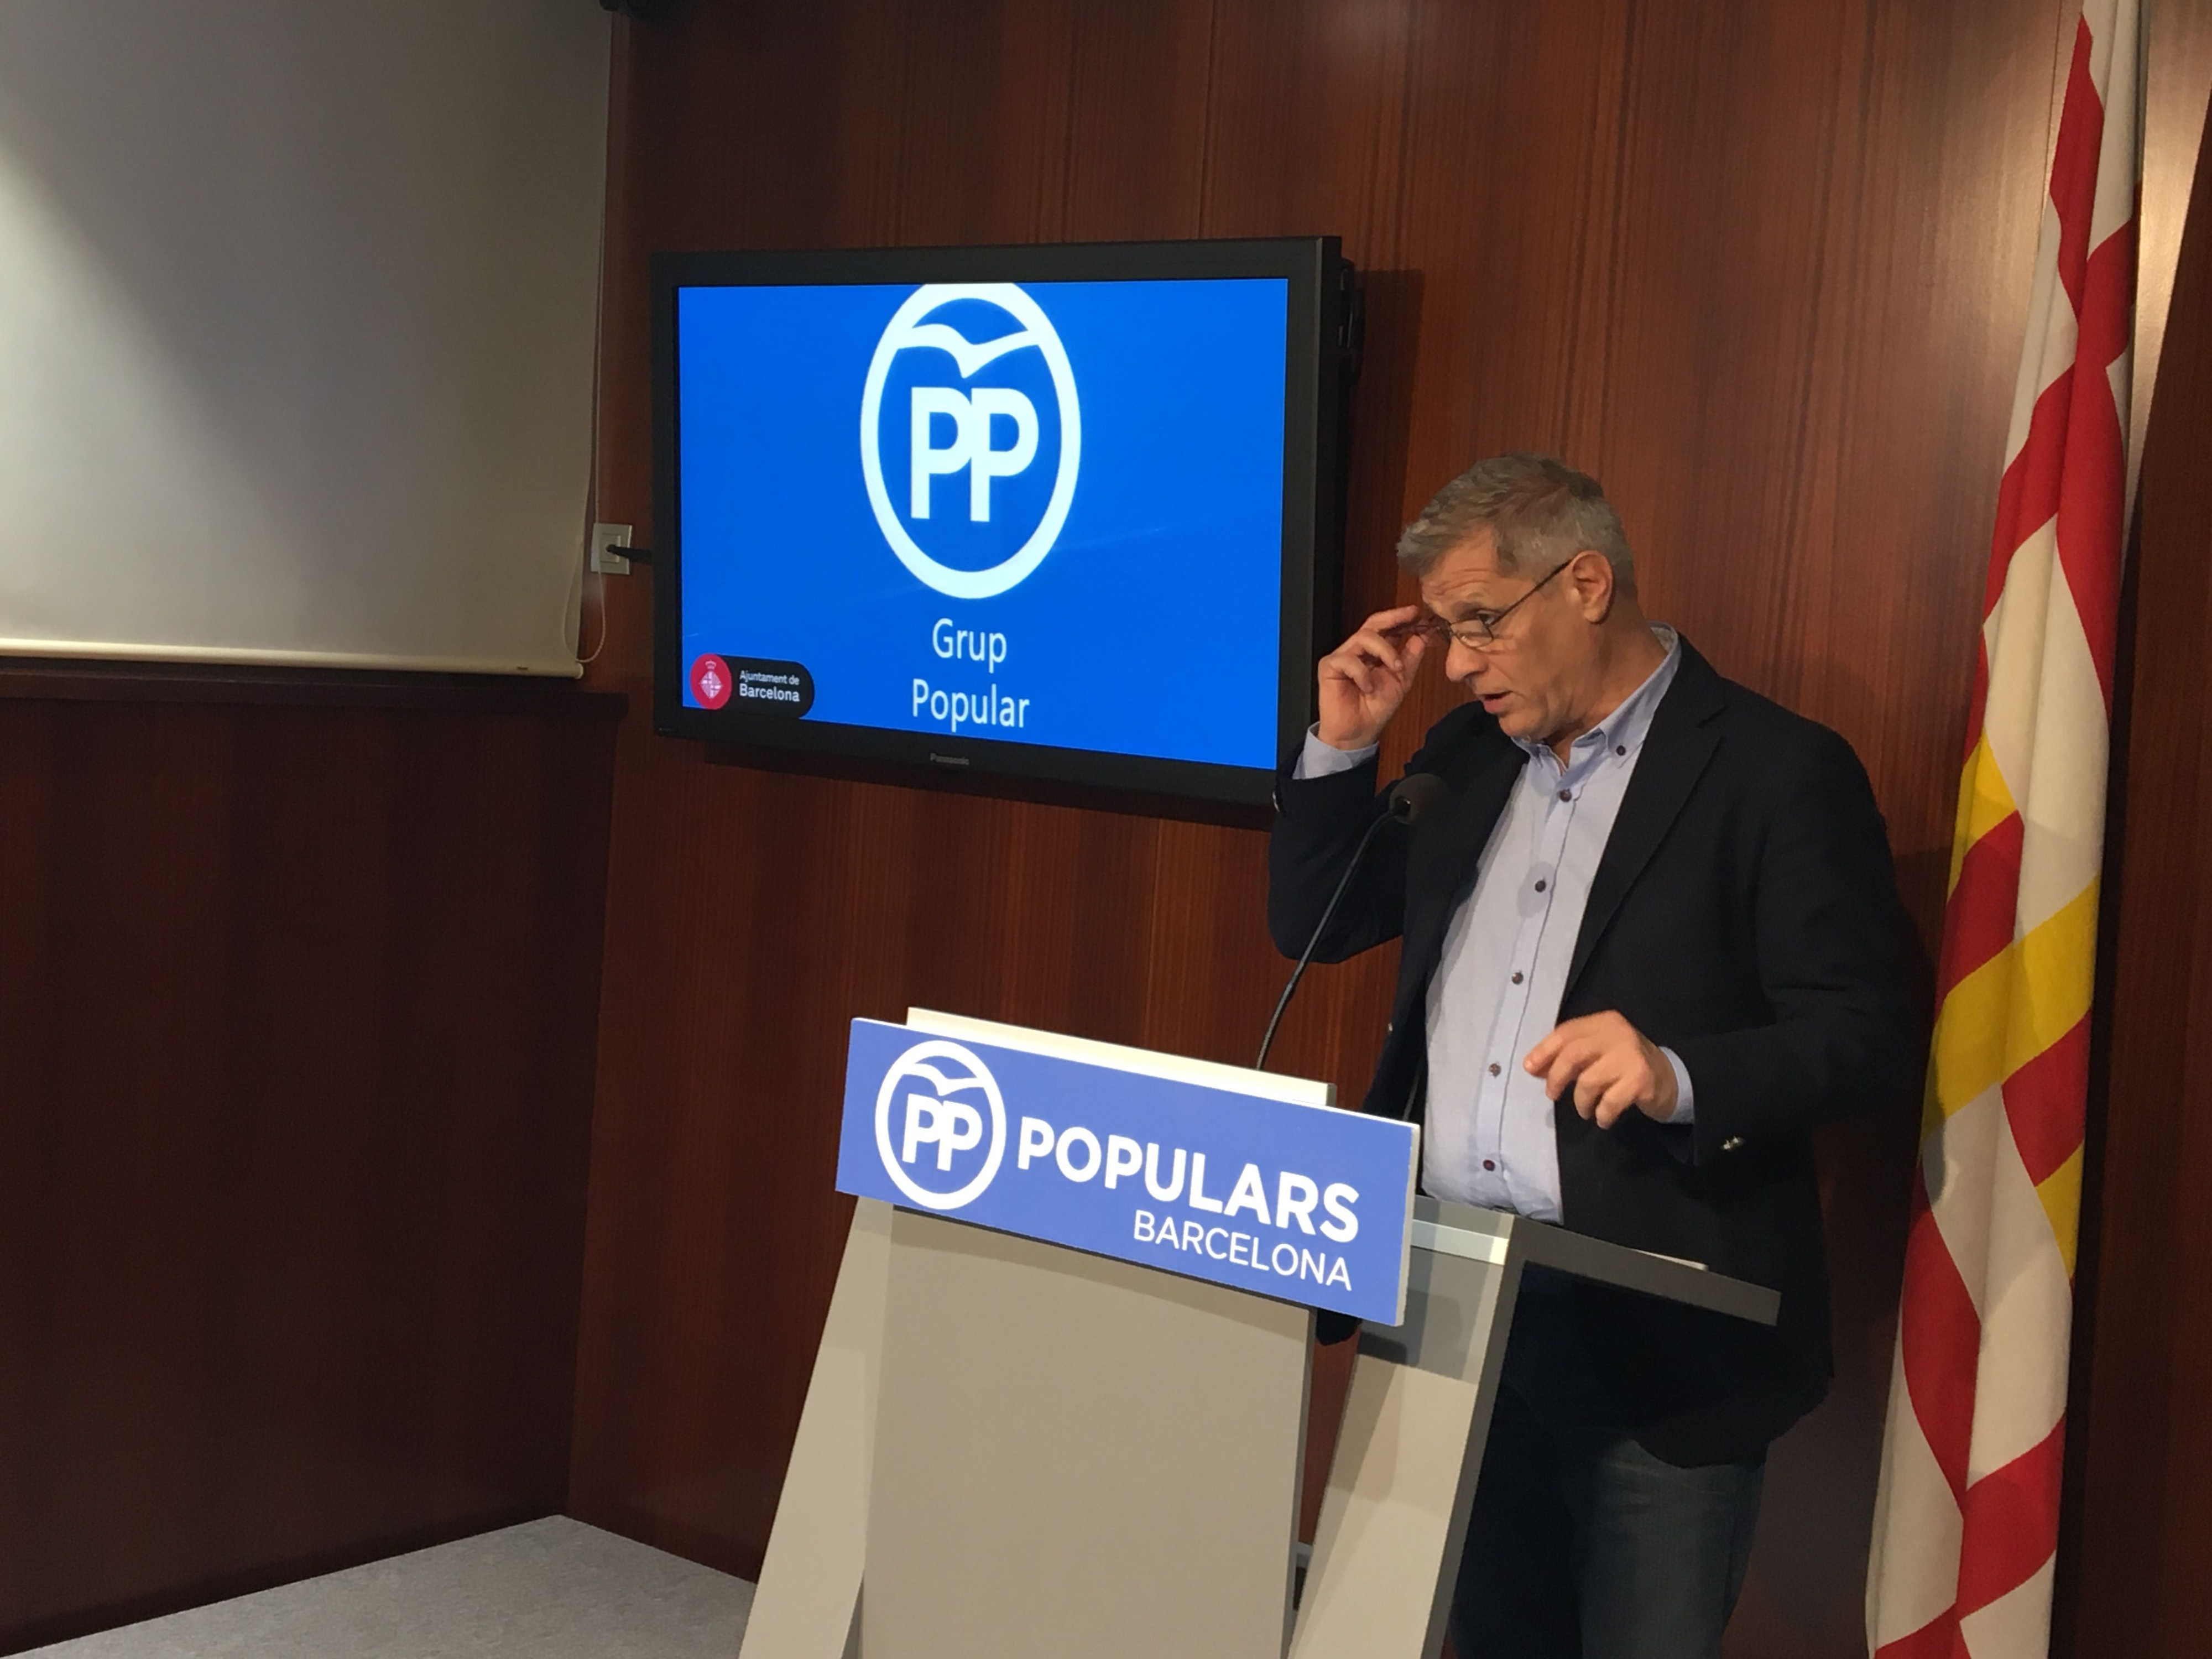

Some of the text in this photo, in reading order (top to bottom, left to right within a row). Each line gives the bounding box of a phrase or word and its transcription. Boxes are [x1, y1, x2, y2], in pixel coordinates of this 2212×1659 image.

[911, 387, 1039, 521] PP
[739, 670, 800, 685] Ajuntament de
[933, 618, 1006, 673] Grup
[739, 683, 800, 702] Barcelona
[912, 679, 1029, 732] Popular
[902, 1093, 983, 1171] PP
[1017, 1116, 1359, 1243] POPULARS
[1133, 1209, 1352, 1291] BARCELONA
